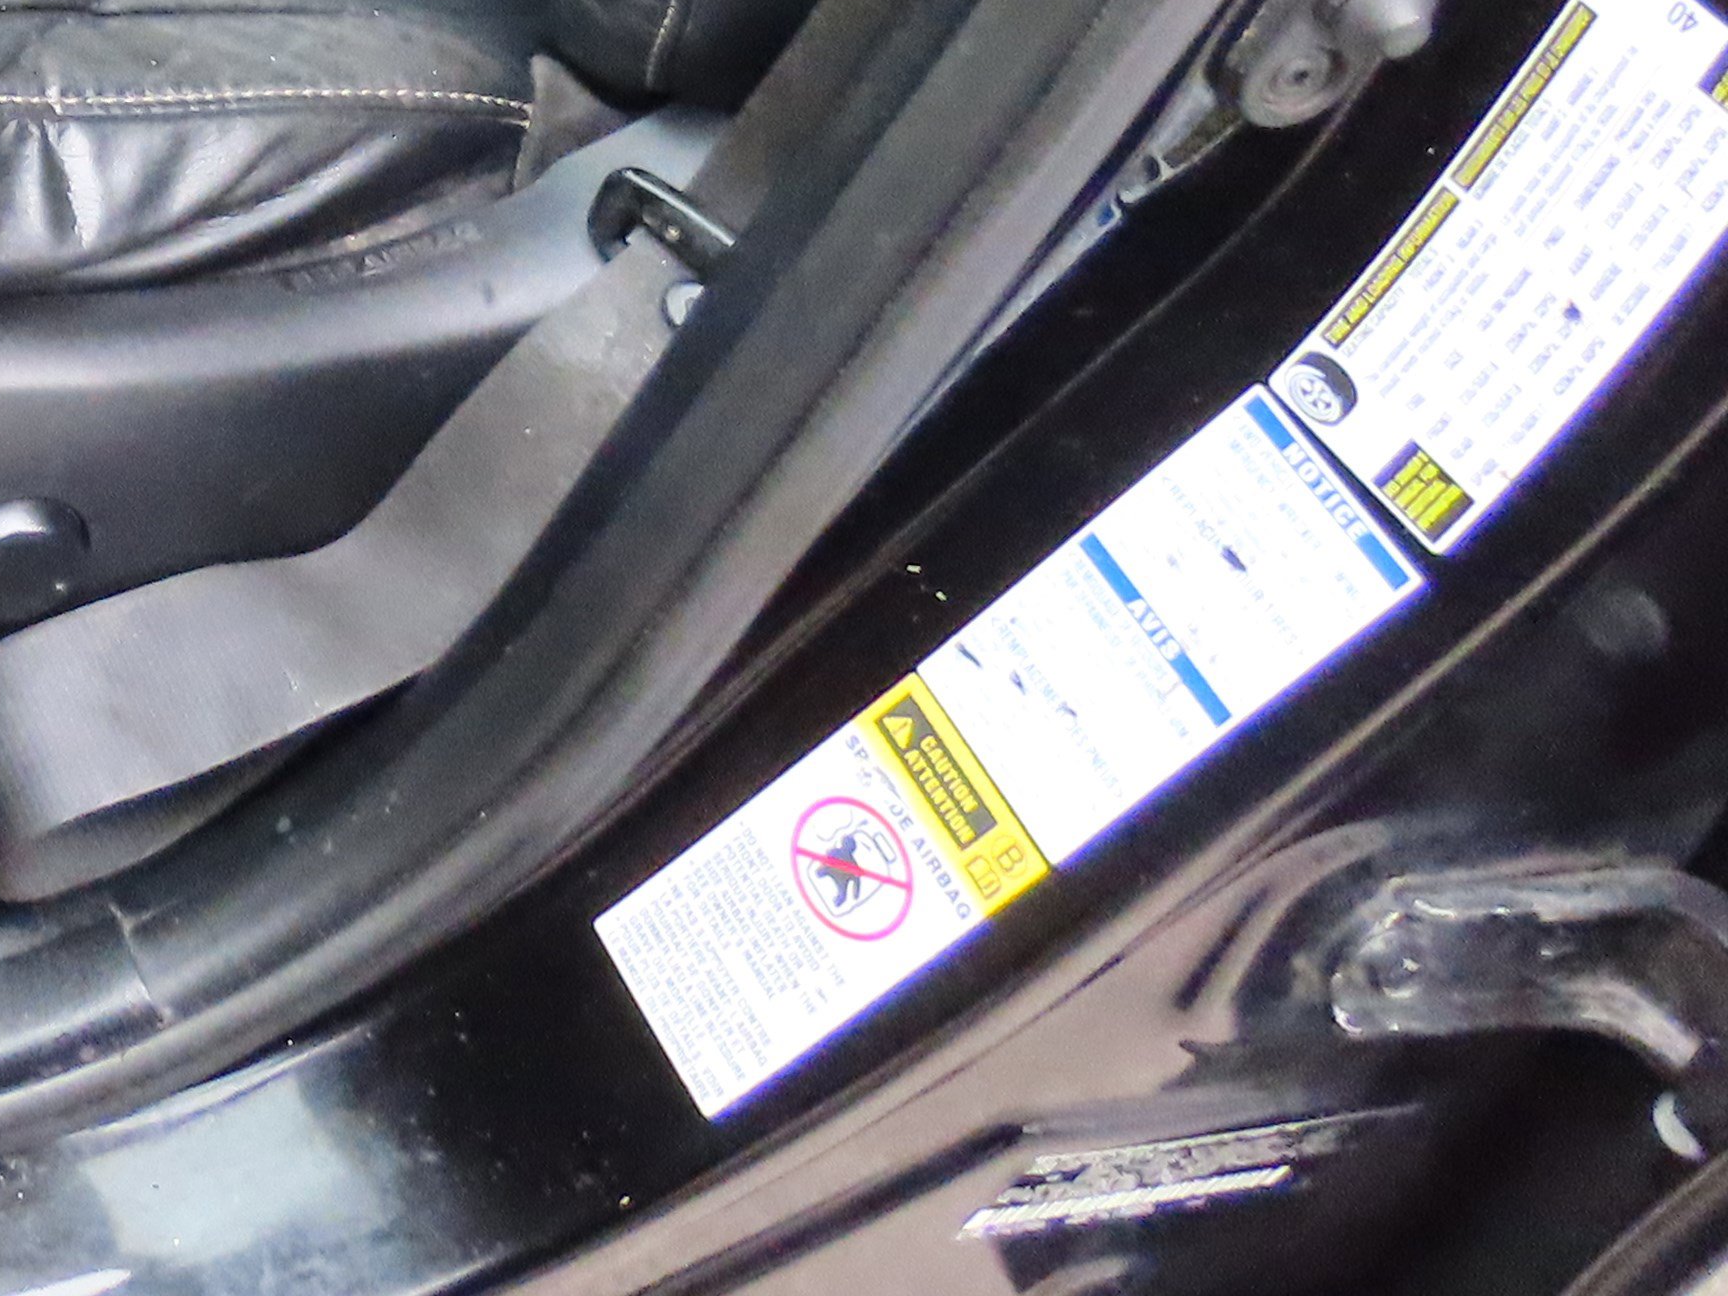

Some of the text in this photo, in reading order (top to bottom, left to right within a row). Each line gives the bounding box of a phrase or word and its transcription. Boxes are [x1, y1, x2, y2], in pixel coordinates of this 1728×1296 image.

[1278, 439, 1370, 545] NOTICE
[1122, 593, 1186, 665] AVIS
[901, 745, 978, 849] ATTENTION
[917, 732, 981, 817] CAUTION
[909, 833, 974, 922] AIRBAG
[994, 843, 1026, 874] B
